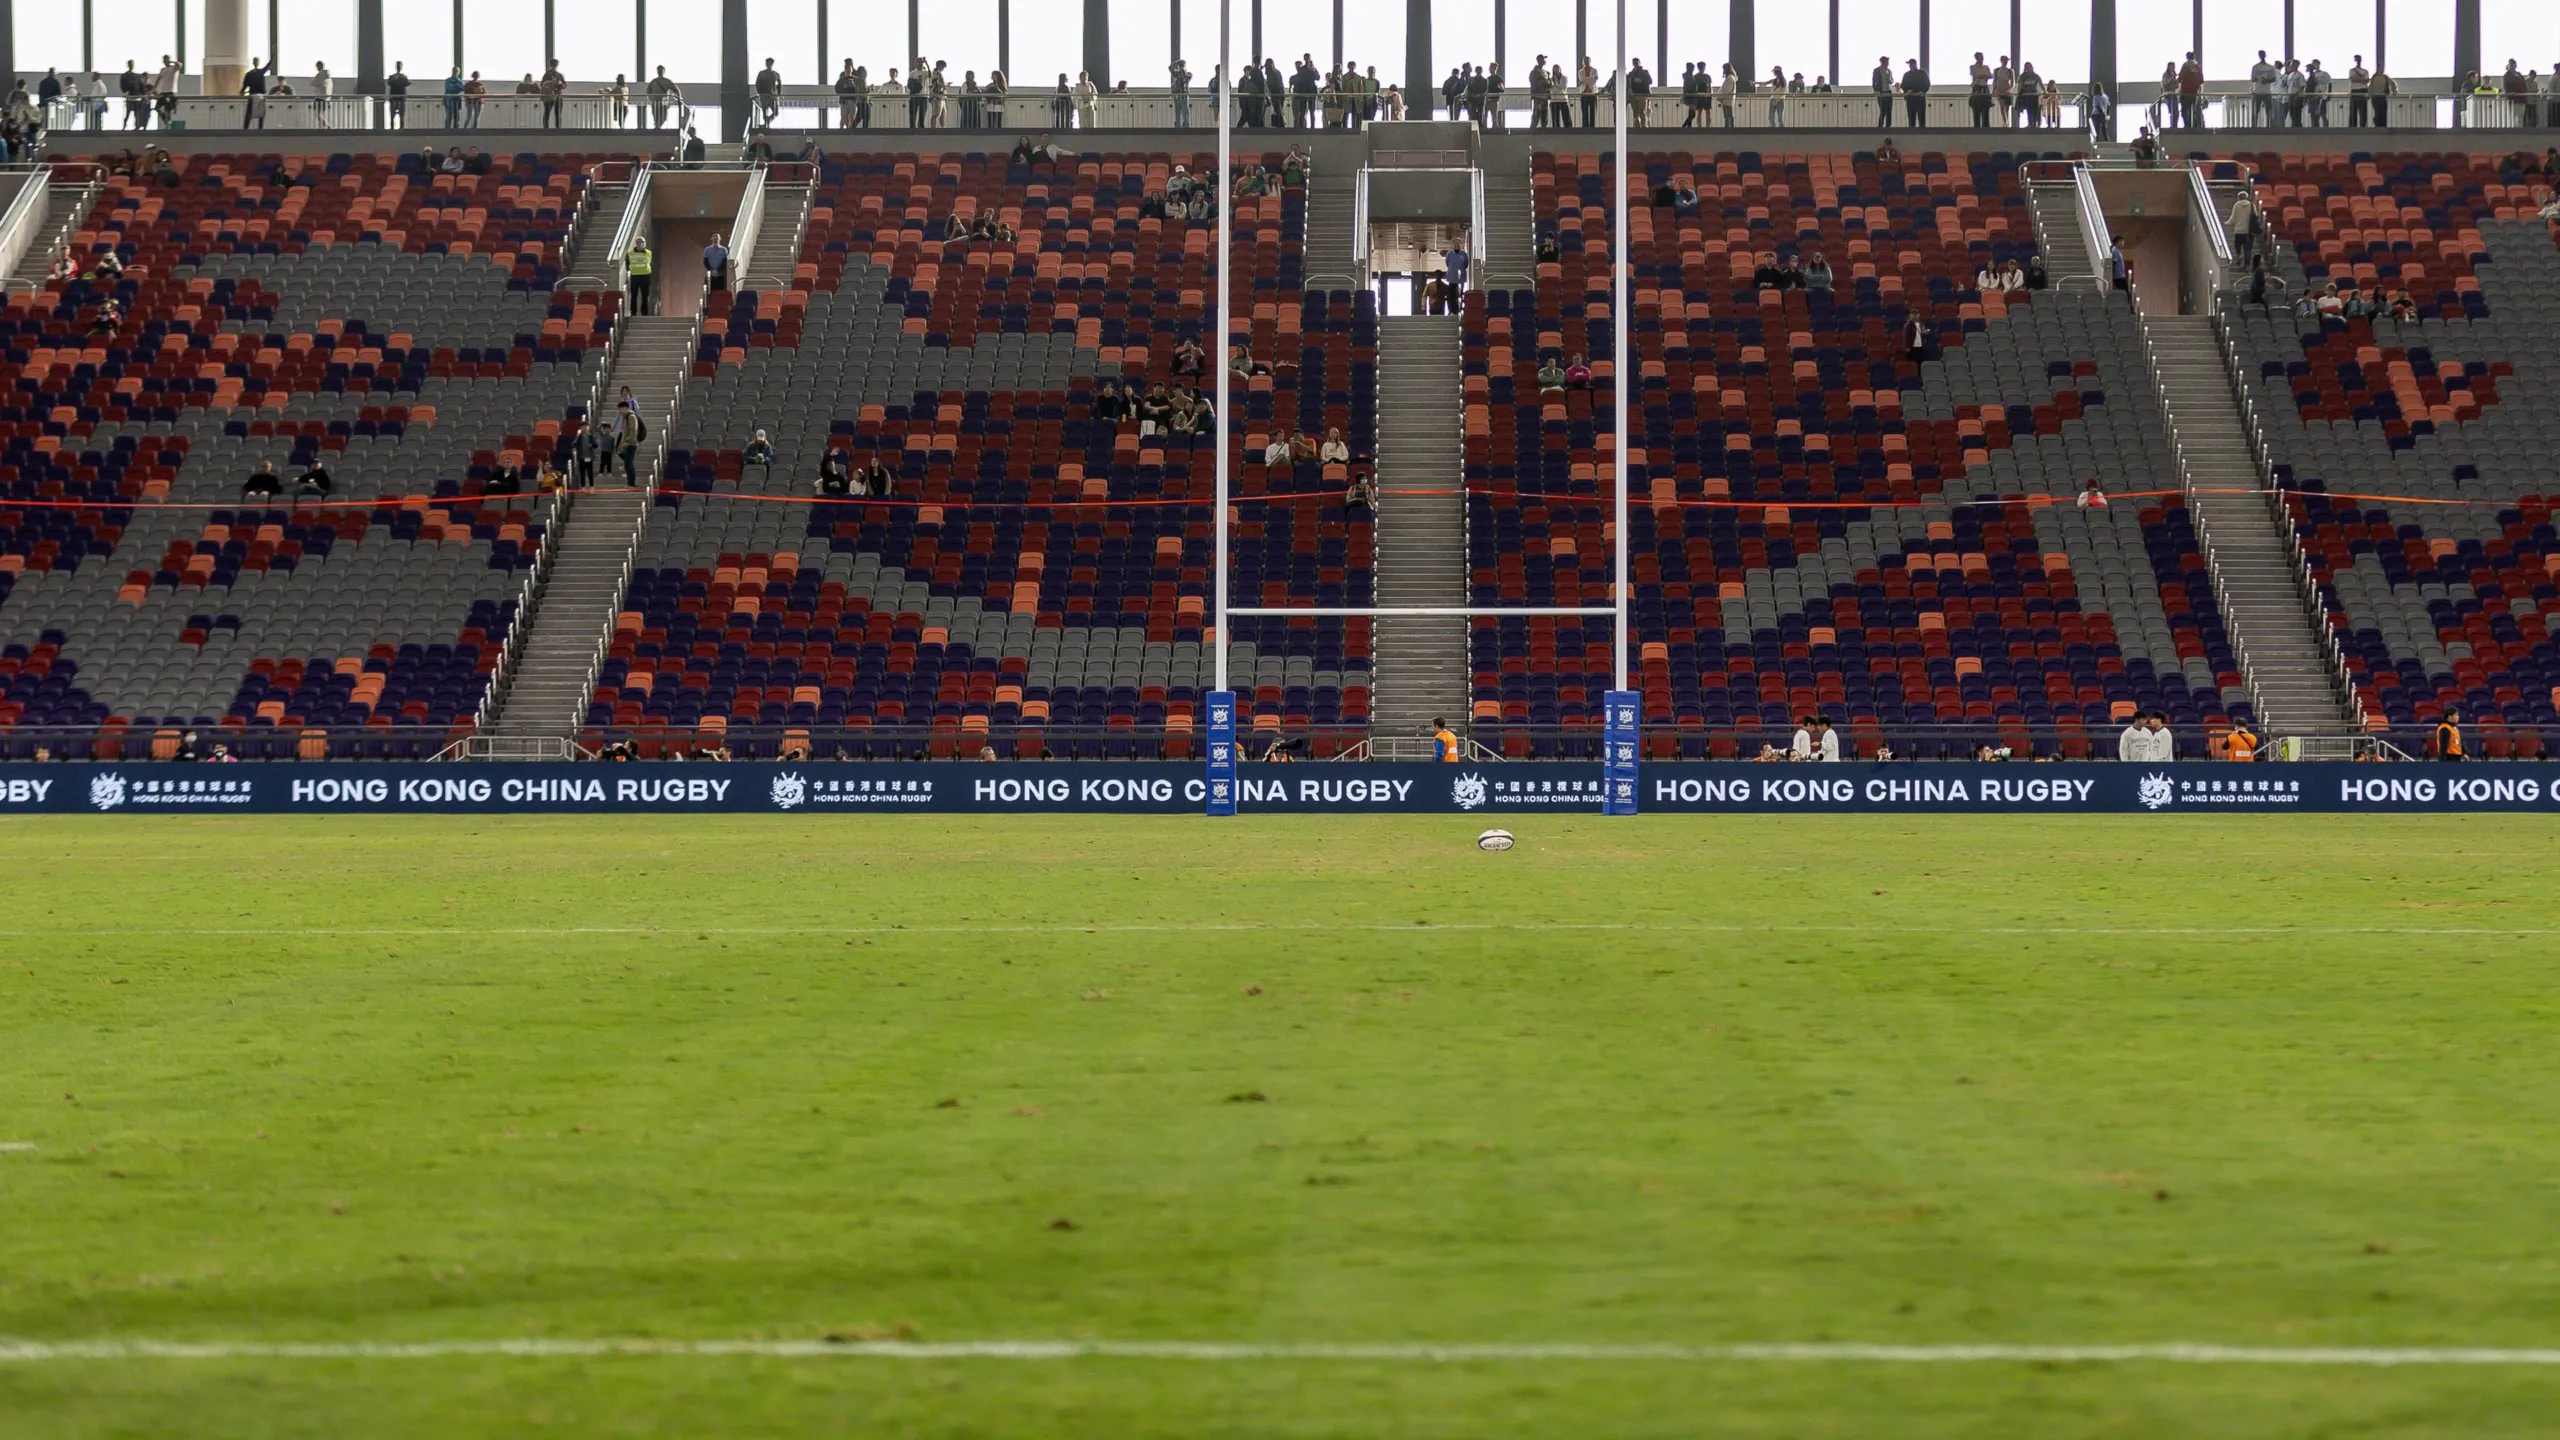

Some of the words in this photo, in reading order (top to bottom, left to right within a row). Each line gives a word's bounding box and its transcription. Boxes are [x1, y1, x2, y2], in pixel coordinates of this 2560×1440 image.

[293, 779, 389, 802] HONG
[400, 779, 492, 802] KONG
[502, 779, 607, 802] CHINA
[618, 779, 731, 802] RUGBY
[976, 779, 1070, 802] HONG
[1082, 779, 1173, 802] KONG
[1184, 779, 1289, 802] CINA
[1301, 779, 1414, 802] RUGBY
[1495, 780, 1598, 792] 中國香港欖球總
[1656, 779, 1751, 802] HONG
[1762, 779, 1854, 802] KONG
[1865, 779, 1970, 802] CHINA
[1981, 779, 2095, 802] RUGBY
[2342, 779, 2437, 802] HONG
[2448, 779, 2540, 802] KONG
[813, 794, 841, 803] HONG
[842, 794, 869, 803] KONG
[870, 794, 900, 803] CHINA
[900, 794, 933, 803] RUGBY
[1495, 794, 1522, 803] HONG
[1523, 794, 1550, 803] KONG
[1551, 794, 1580, 803] CHINA
[1582, 794, 1604, 803] RUG
[2181, 794, 2208, 803] HONG
[2209, 794, 2236, 803] KONG
[2237, 794, 2267, 803] CHINA
[2268, 794, 2300, 803] RUGBY
